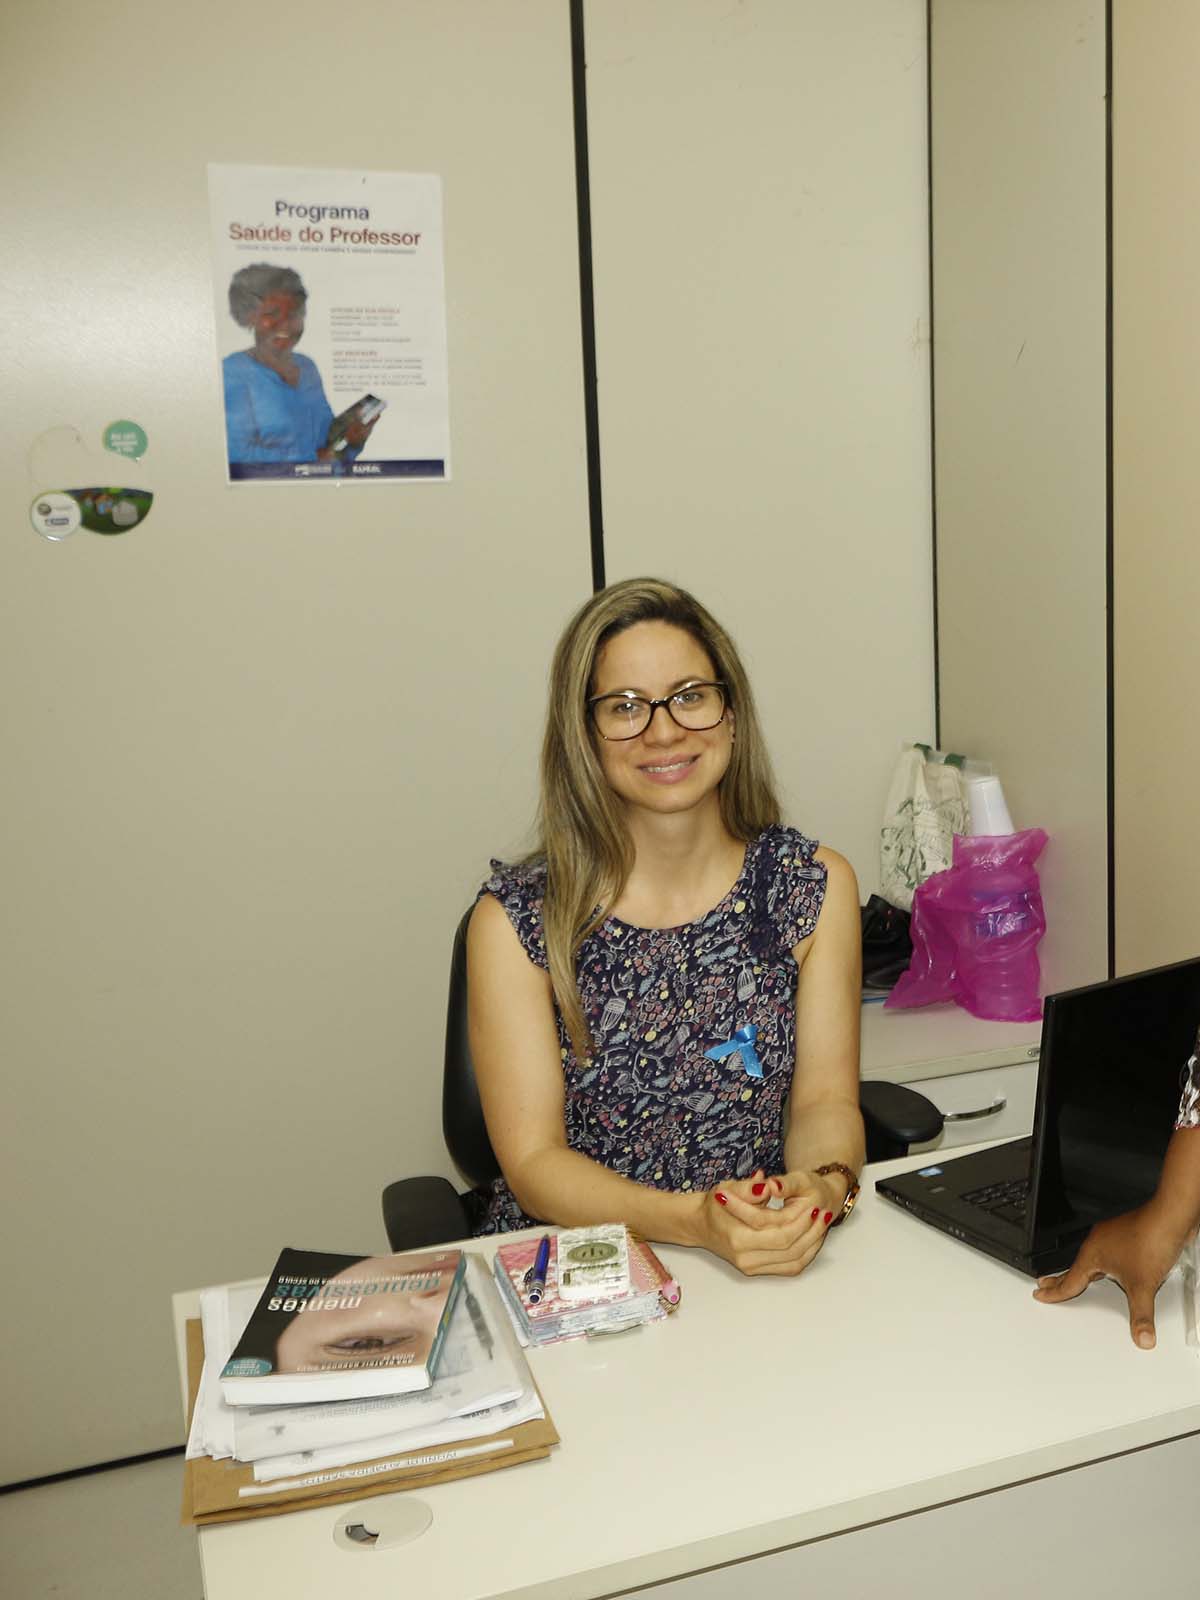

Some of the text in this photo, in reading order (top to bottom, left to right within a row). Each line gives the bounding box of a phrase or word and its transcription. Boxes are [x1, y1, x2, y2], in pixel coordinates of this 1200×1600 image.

[274, 200, 370, 223] Programa
[229, 222, 421, 246] Saúde do Professor
[267, 1296, 362, 1313] mentes
